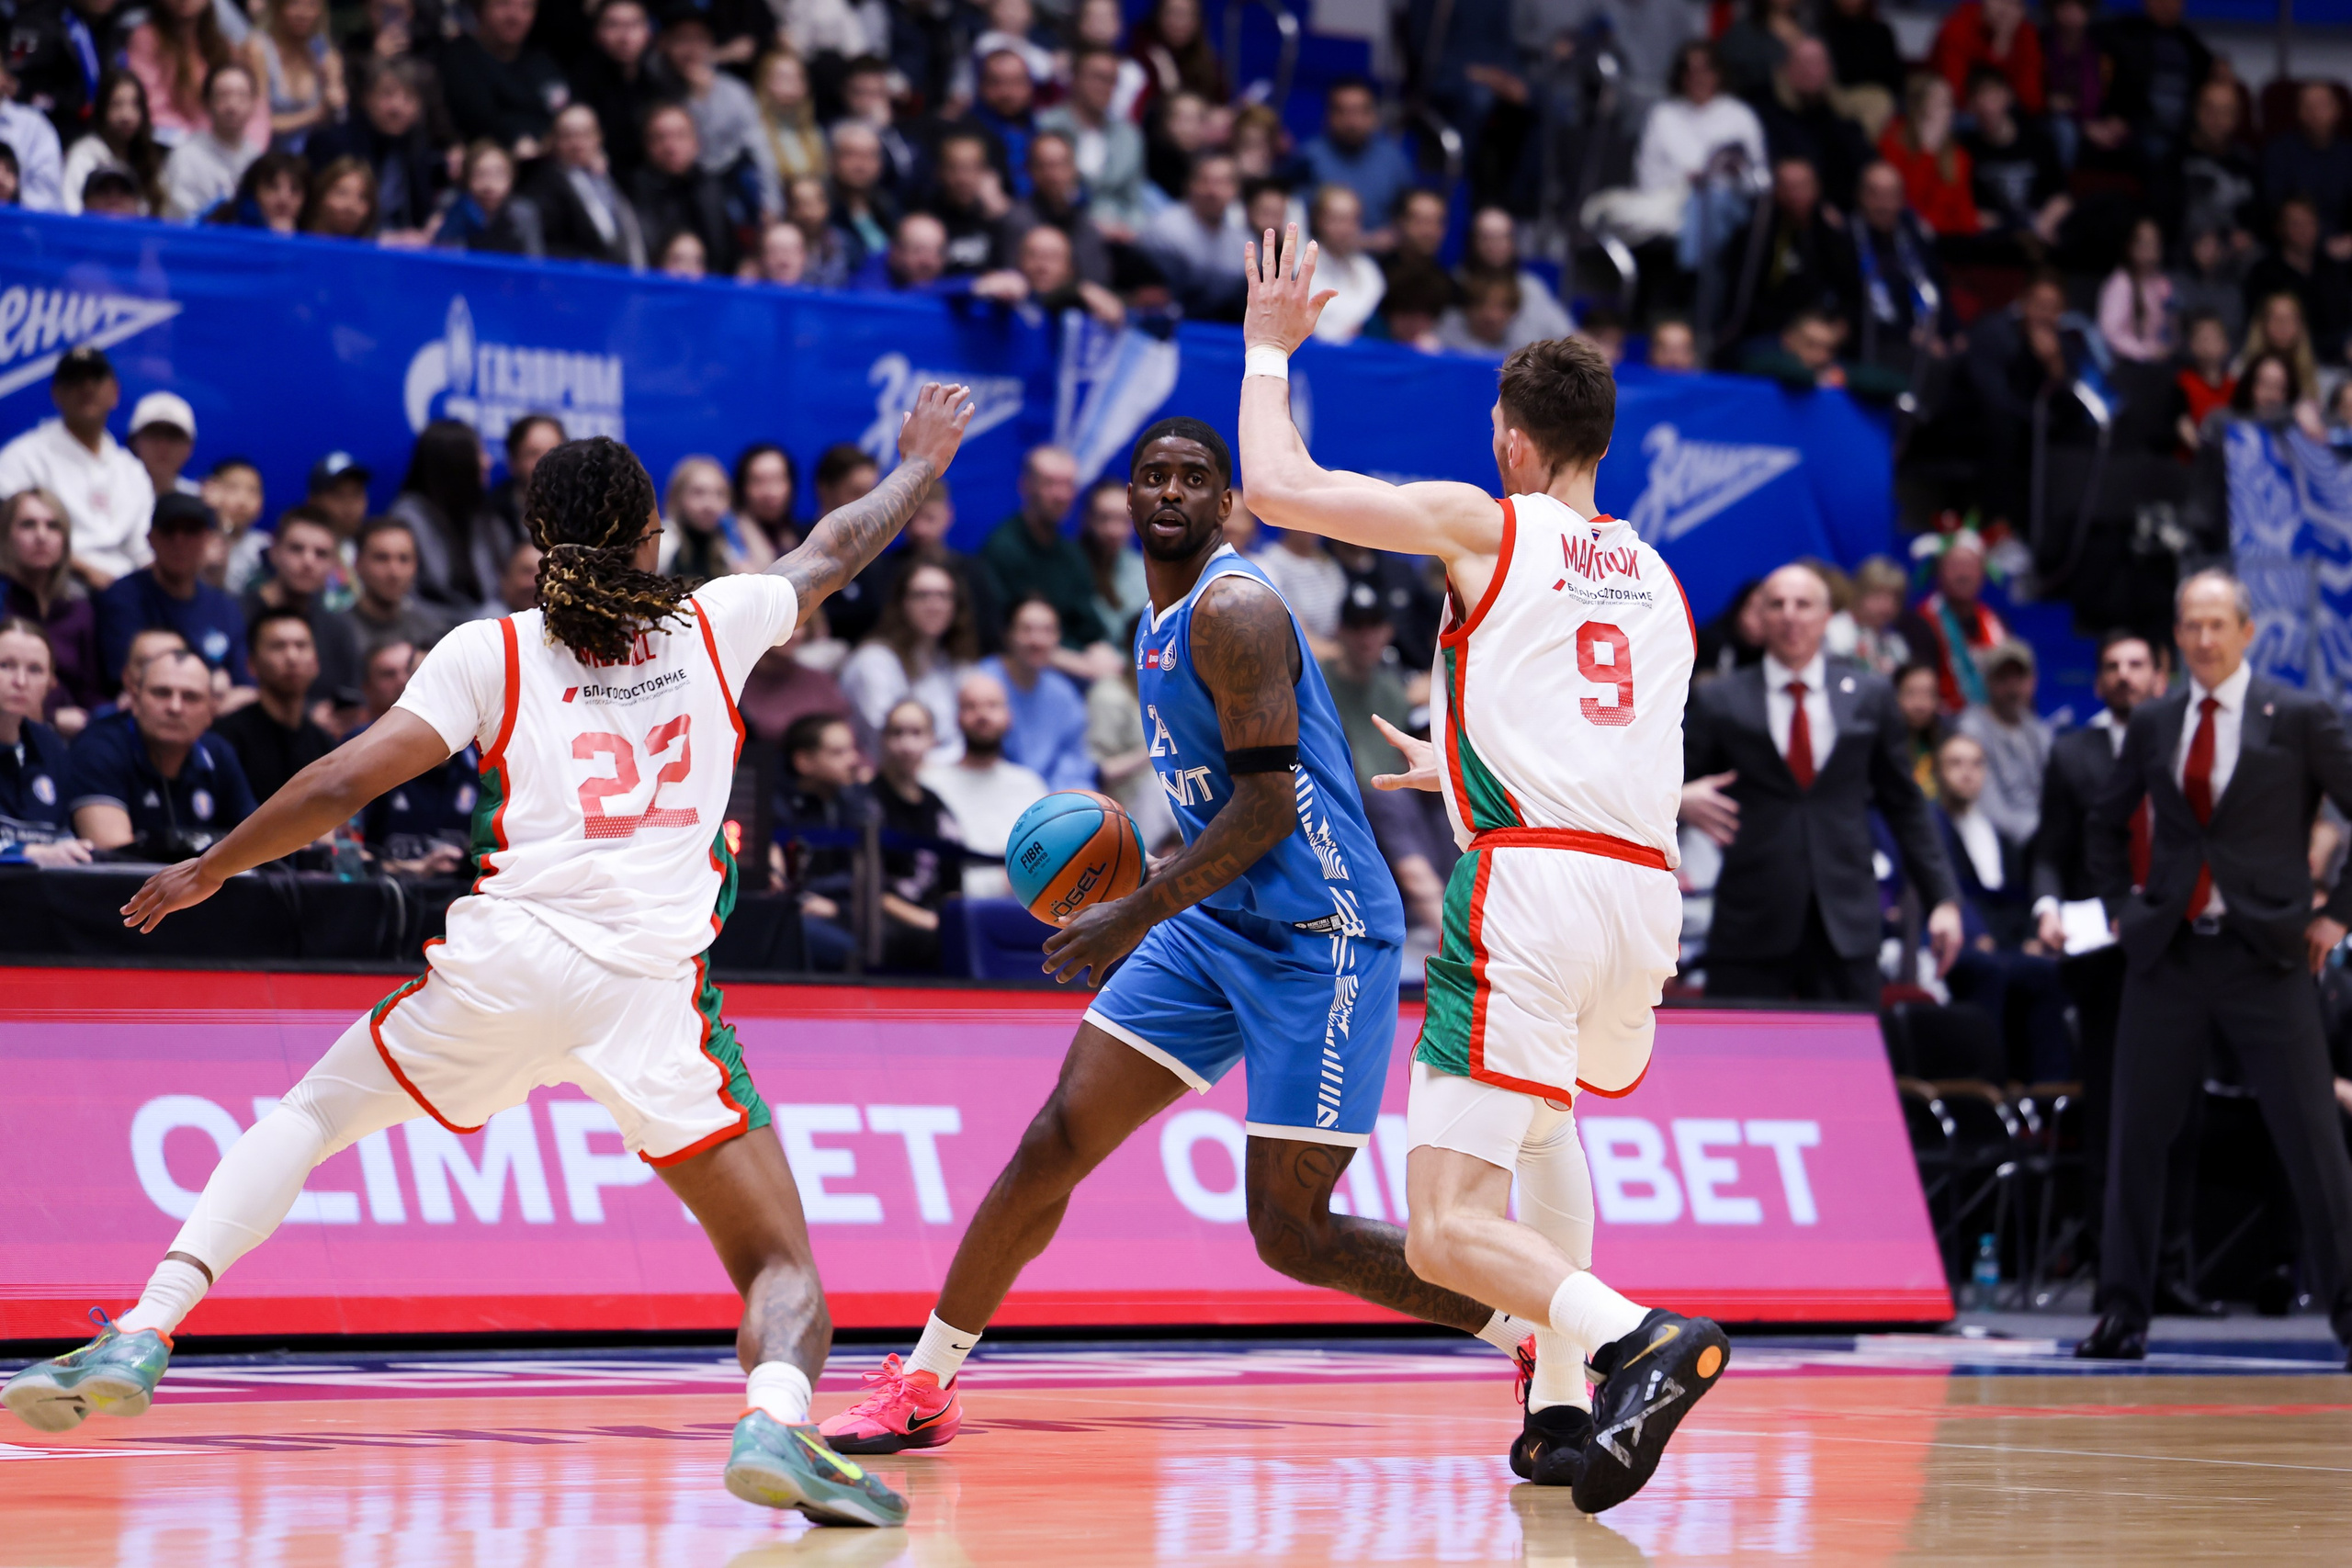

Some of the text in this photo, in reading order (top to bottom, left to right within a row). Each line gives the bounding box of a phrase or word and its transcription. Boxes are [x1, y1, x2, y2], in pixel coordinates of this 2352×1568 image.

[0, 284, 184, 375] енит
[1576, 620, 1636, 727] 9
[571, 714, 700, 840] 22
[1159, 765, 1214, 807] NIT
[1020, 840, 1045, 870] FIBA
[1027, 852, 1049, 874] APPROVED
[130, 1093, 962, 1225] OLIMPET
[1159, 1108, 1822, 1226] OIBET
